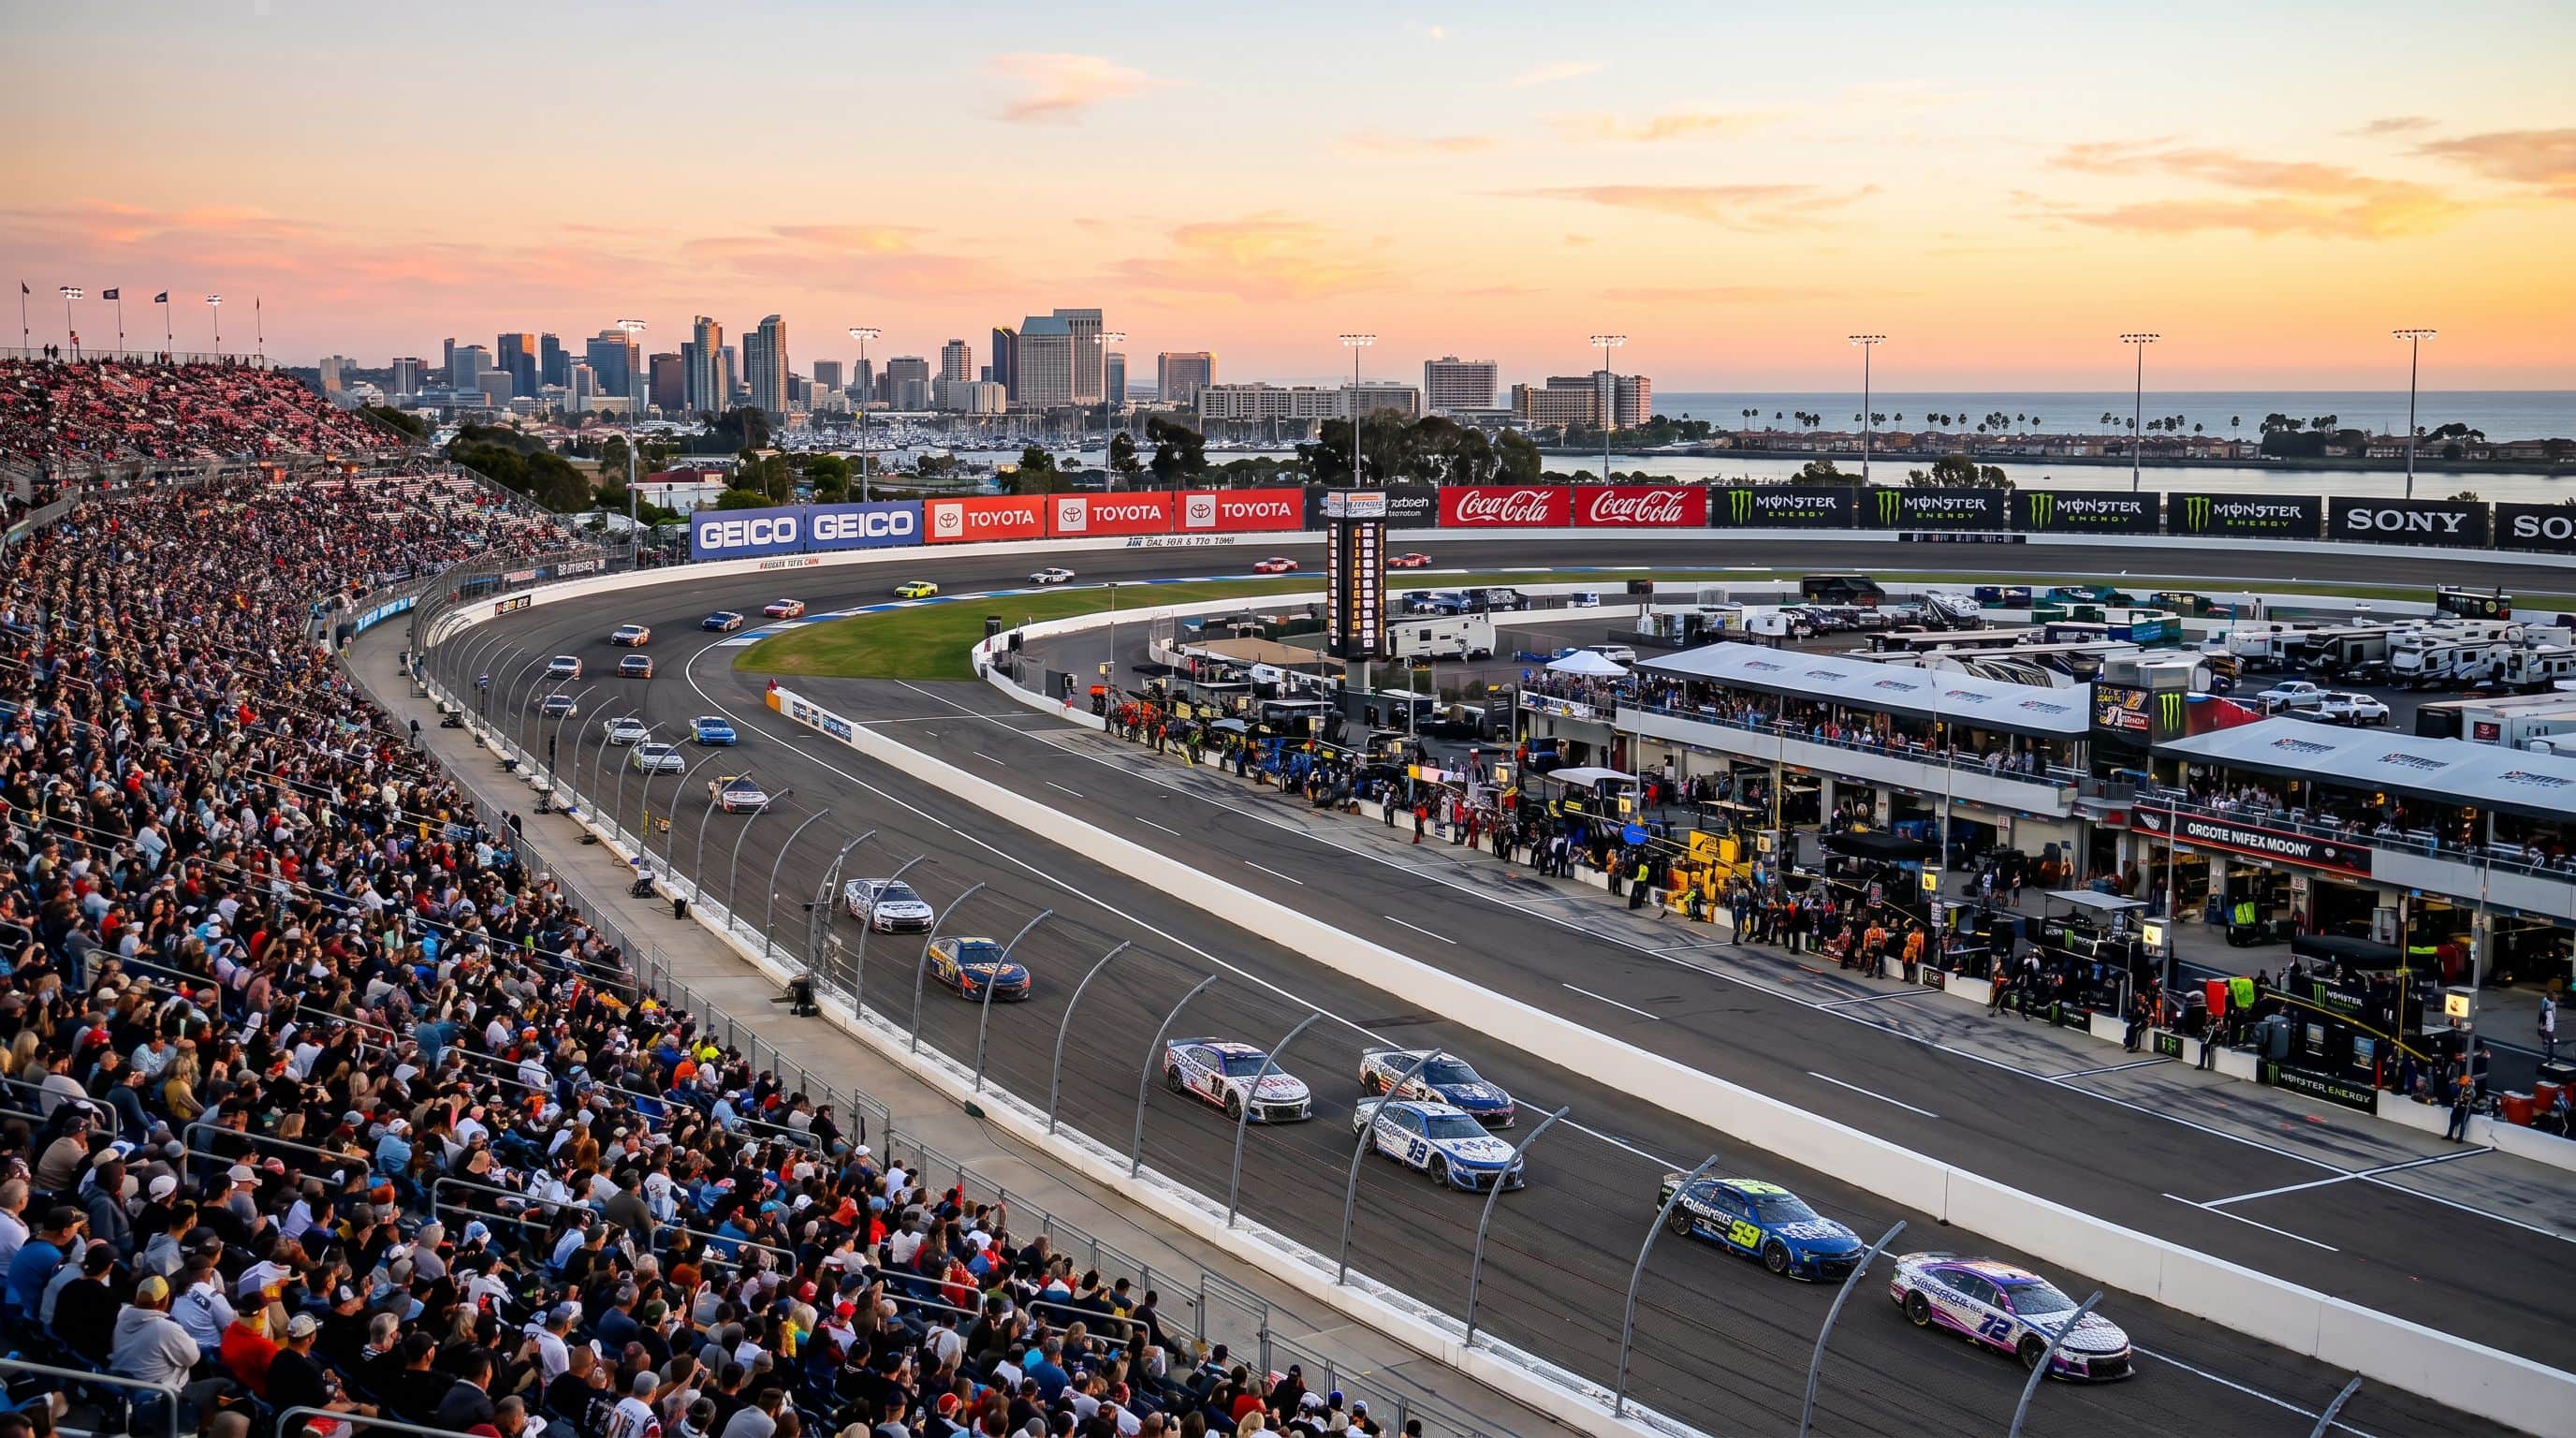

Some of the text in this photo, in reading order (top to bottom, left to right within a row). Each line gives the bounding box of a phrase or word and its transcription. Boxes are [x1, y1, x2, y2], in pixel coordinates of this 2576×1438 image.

[968, 509, 1035, 527] TOYOTA
[1092, 505, 1162, 521] TOYOTA
[1222, 501, 1292, 518] TOYOTA
[1456, 490, 1554, 522] Coca-Cola
[1589, 490, 1689, 522] Coca-Cola
[2347, 508, 2467, 533] SONY
[699, 517, 798, 550] GEICO
[813, 510, 915, 540] GEICO
[2513, 515, 2576, 539] SO
[1727, 1219, 1761, 1249] 59
[1977, 1313, 2014, 1343] 72
